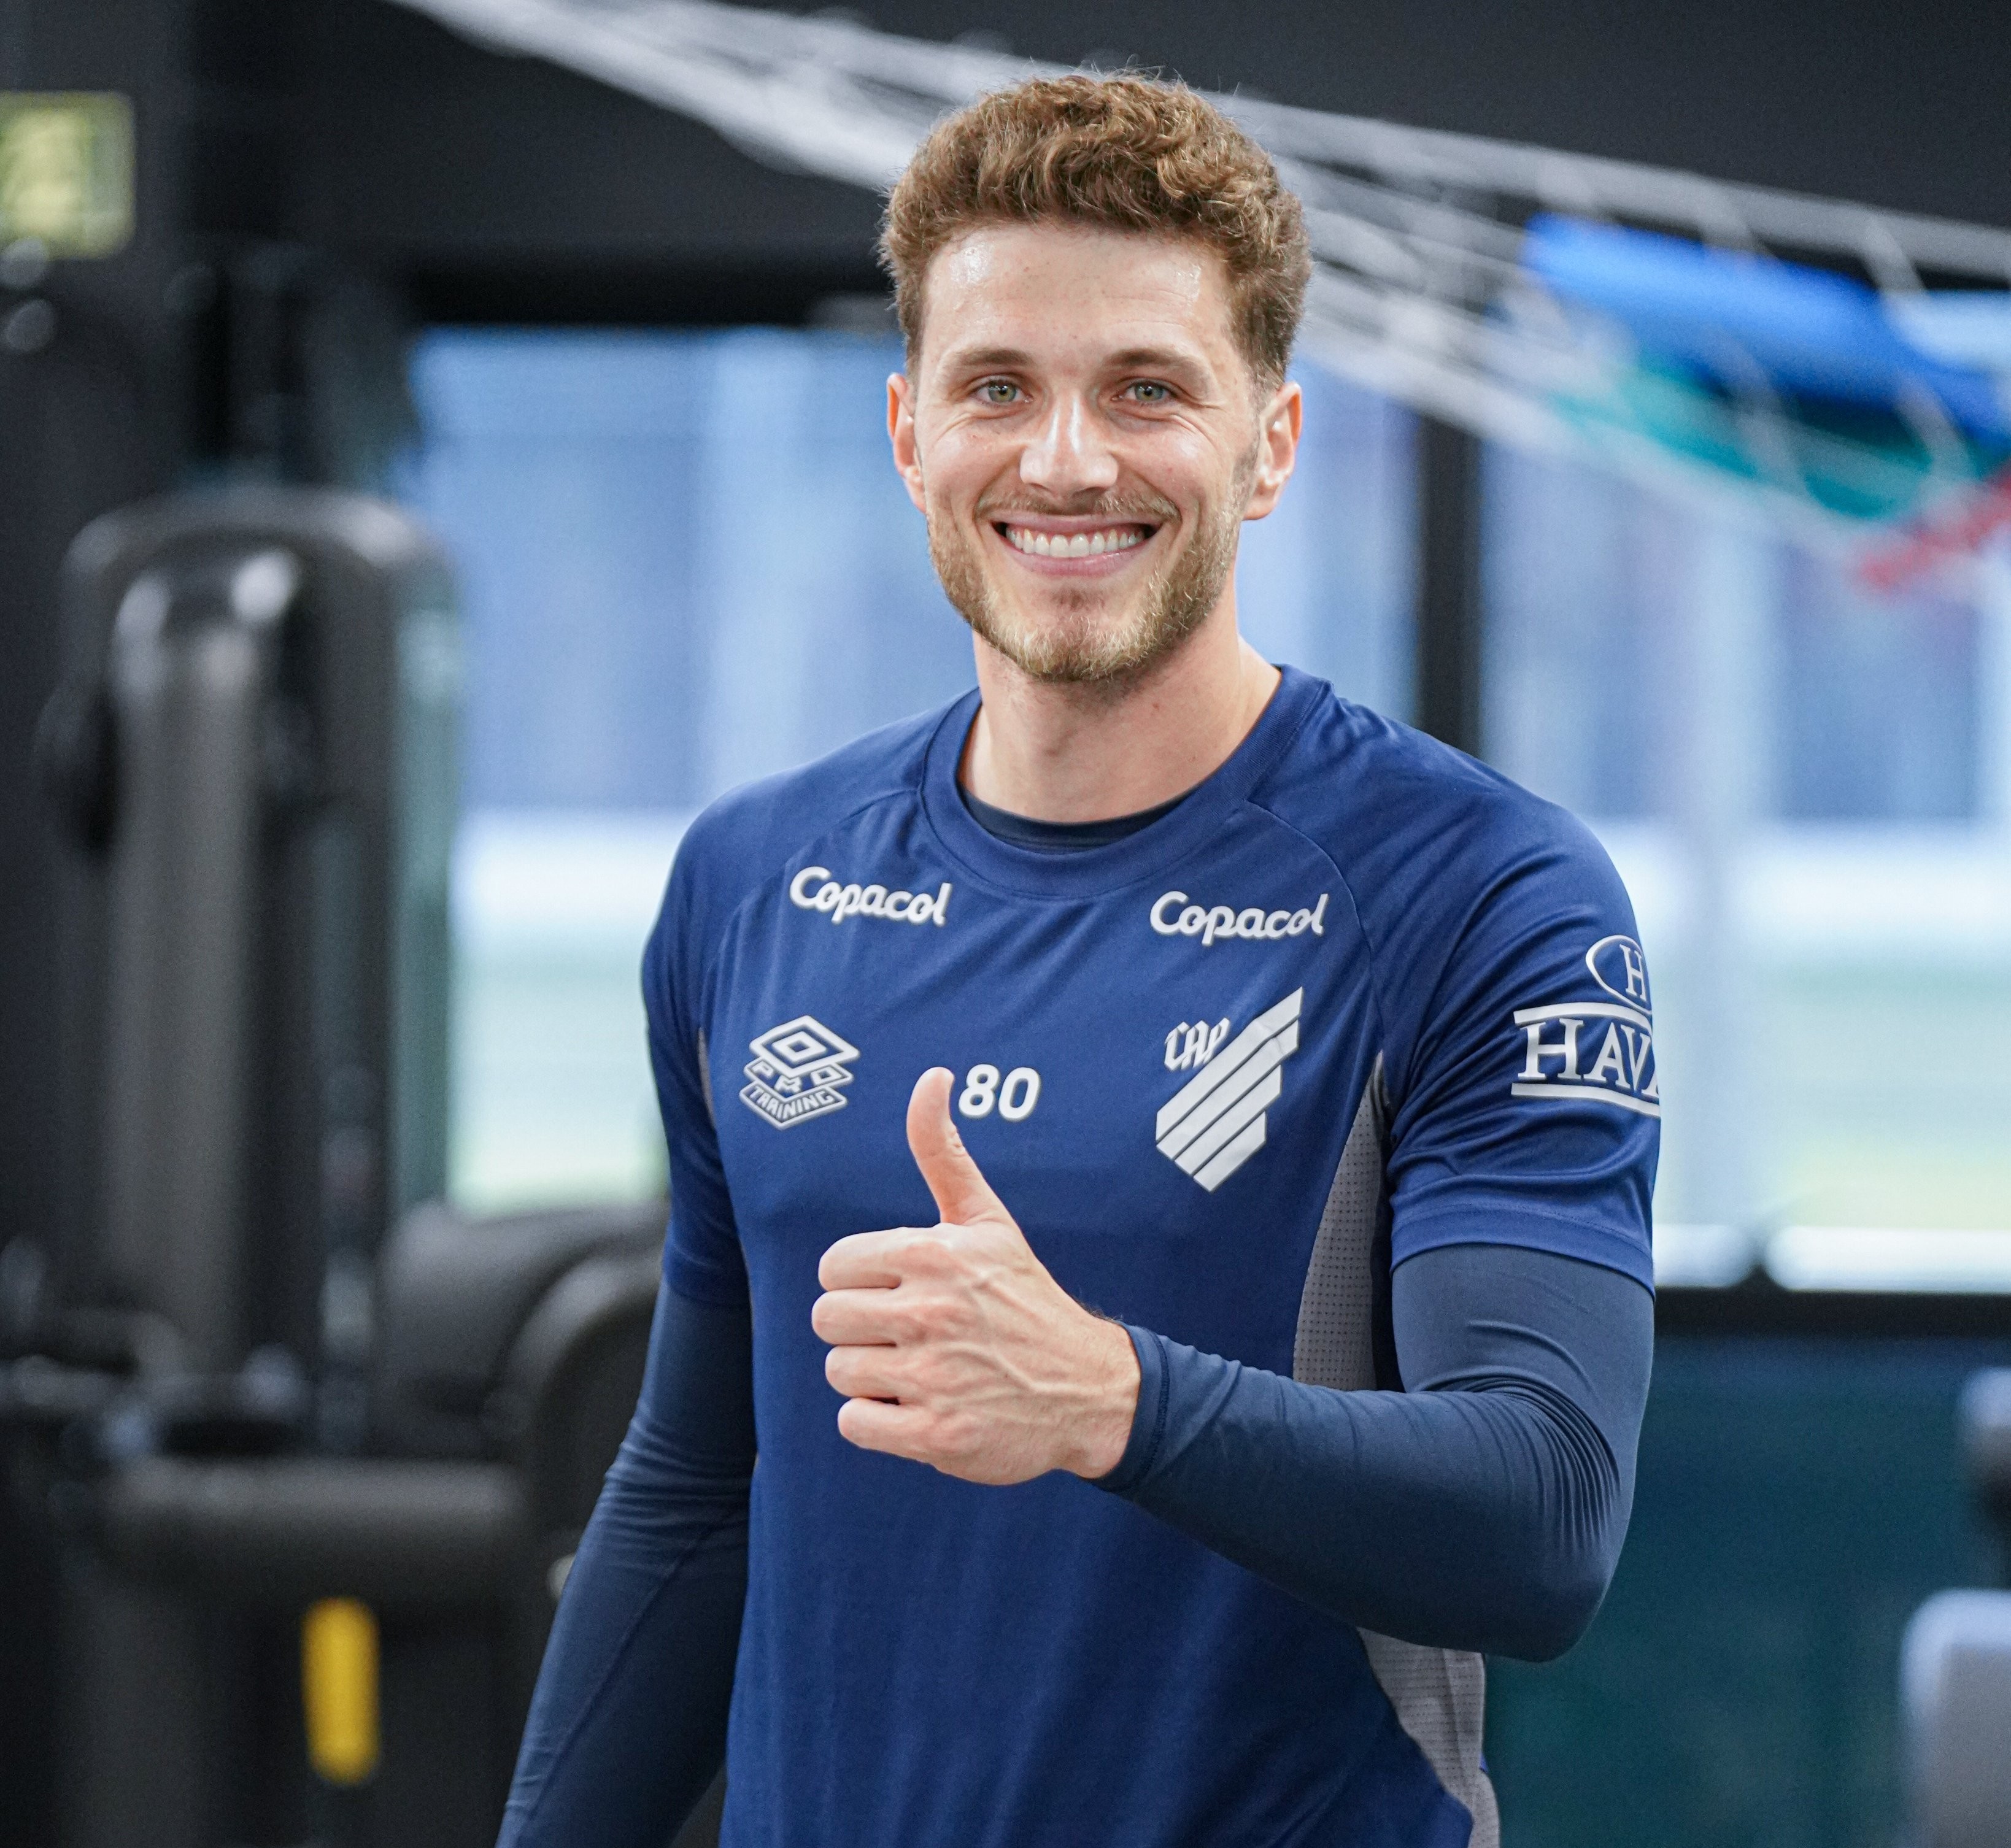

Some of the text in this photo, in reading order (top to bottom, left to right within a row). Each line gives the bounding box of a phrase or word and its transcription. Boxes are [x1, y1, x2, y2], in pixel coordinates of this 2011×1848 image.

[790, 866, 952, 926] Copacol
[1150, 891, 1329, 946] Copacol
[1619, 944, 1646, 1003] H
[749, 1086, 835, 1120] TRAINING
[959, 1064, 1041, 1122] 80
